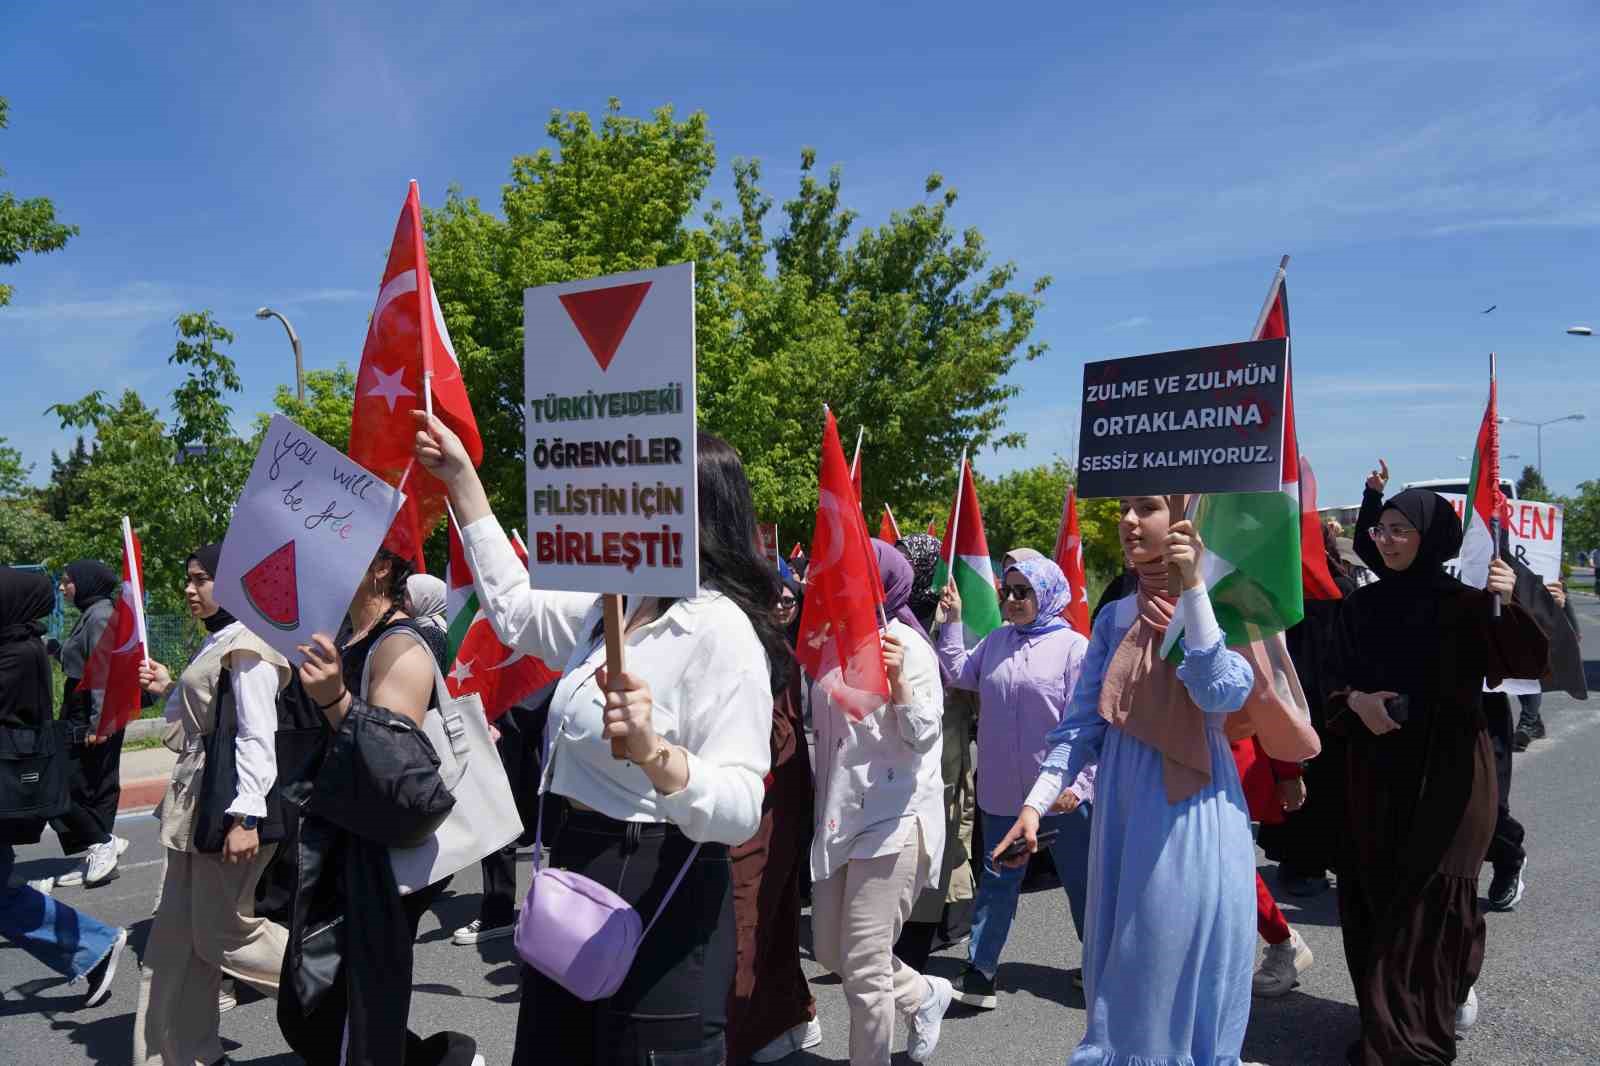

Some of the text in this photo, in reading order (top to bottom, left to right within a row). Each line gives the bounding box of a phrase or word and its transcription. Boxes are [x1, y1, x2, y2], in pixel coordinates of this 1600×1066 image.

[1087, 363, 1276, 402] ZULME VE ZULMÜN
[1093, 403, 1263, 437] ORTAKLARINA
[533, 433, 683, 469] ÖĞRENCİLER
[1081, 445, 1274, 472] SESSİZ KALMIYORUZ.
[281, 480, 304, 511] be
[333, 465, 374, 500] will
[534, 481, 684, 519] FİLİSTİN İÇİN
[536, 523, 684, 574] BİRLEŞTİ!
